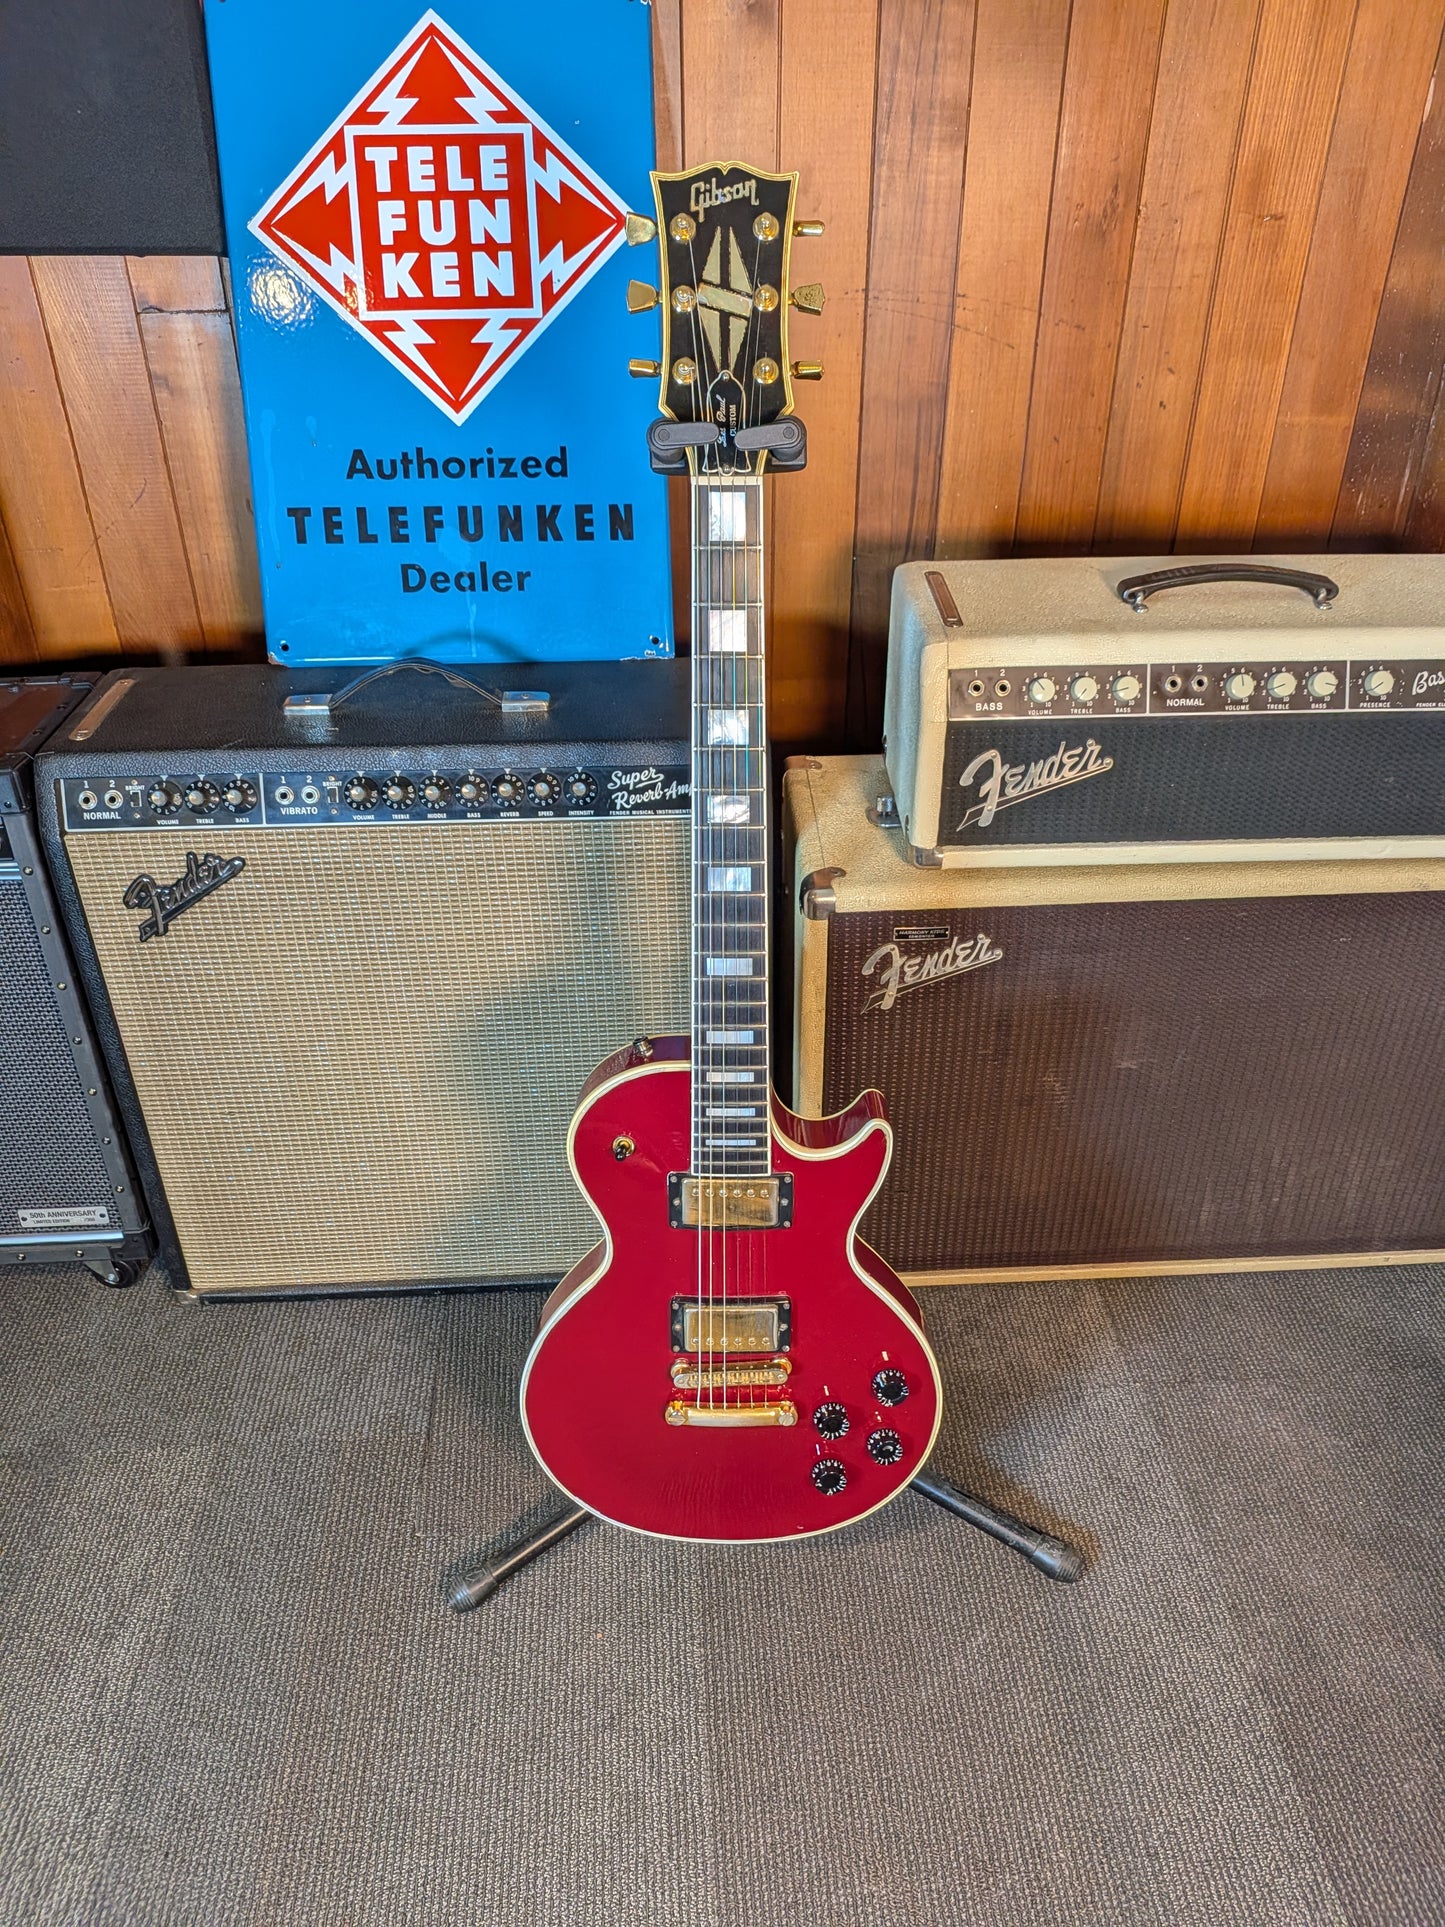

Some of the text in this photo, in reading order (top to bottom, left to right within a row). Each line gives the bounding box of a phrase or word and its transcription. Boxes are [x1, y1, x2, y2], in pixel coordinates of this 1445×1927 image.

[365, 144, 509, 193] TELE
[690, 176, 759, 222] Gibson
[378, 200, 511, 246] FUN
[383, 252, 515, 299] KEN
[716, 394, 726, 422] Paul
[729, 404, 737, 437] CUSTOM
[345, 446, 568, 481] Authorized
[287, 504, 635, 544] TELEFUNKEN
[400, 563, 531, 594] Dealer
[1412, 670, 1445, 695] Bas
[975, 702, 1003, 711] BASS
[1166, 698, 1205, 707] NORMAL
[84, 780, 89, 788] 1
[306, 775, 312, 783] 2
[607, 766, 665, 790] Super
[956, 738, 1114, 832] Fender
[83, 811, 121, 820] NORMAL
[280, 807, 318, 815] VIBRATO
[123, 851, 246, 942] Fender
[860, 934, 1003, 1015] Fender
[47, 1210, 97, 1218] ANNIVERSARY
